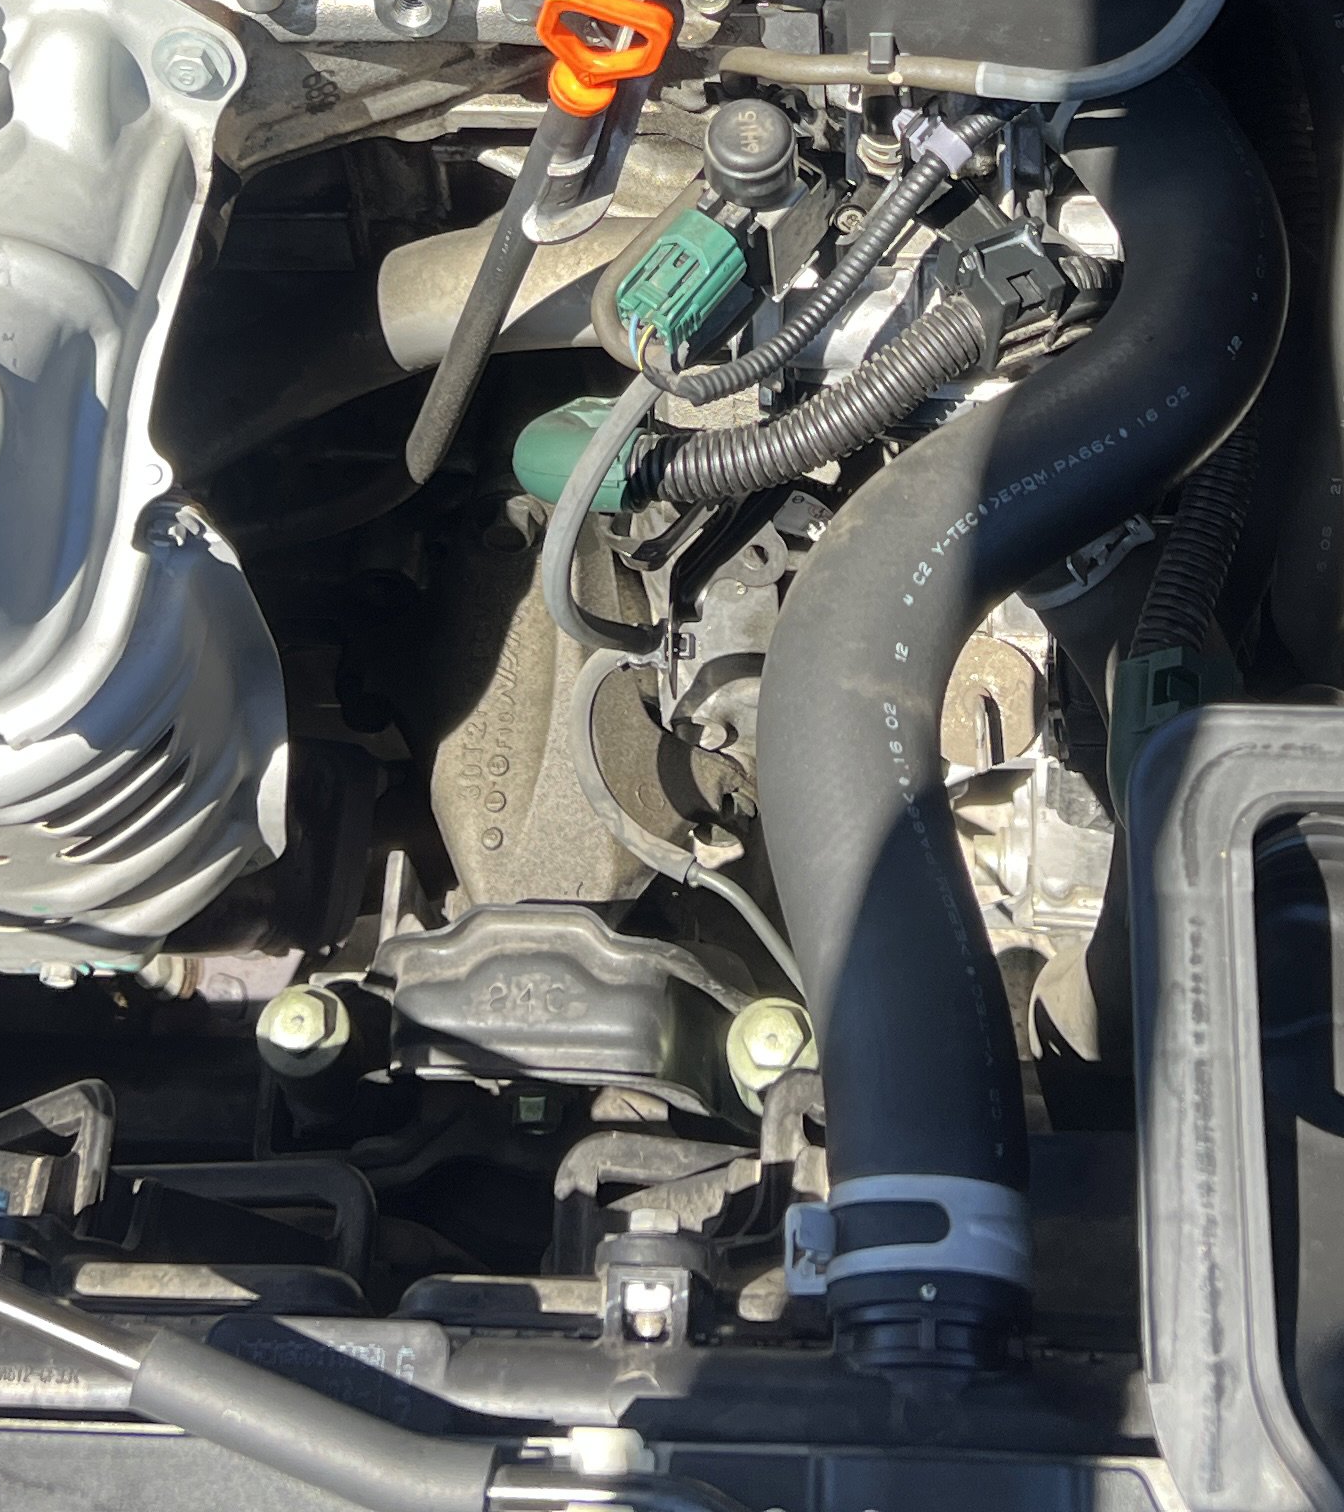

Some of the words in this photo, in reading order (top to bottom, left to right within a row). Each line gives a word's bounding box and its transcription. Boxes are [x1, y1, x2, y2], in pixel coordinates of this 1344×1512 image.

[912, 561, 933, 586] C2
[931, 511, 979, 557] Y-TEC
[884, 702, 899, 729] 02
[895, 642, 910, 663] 12
